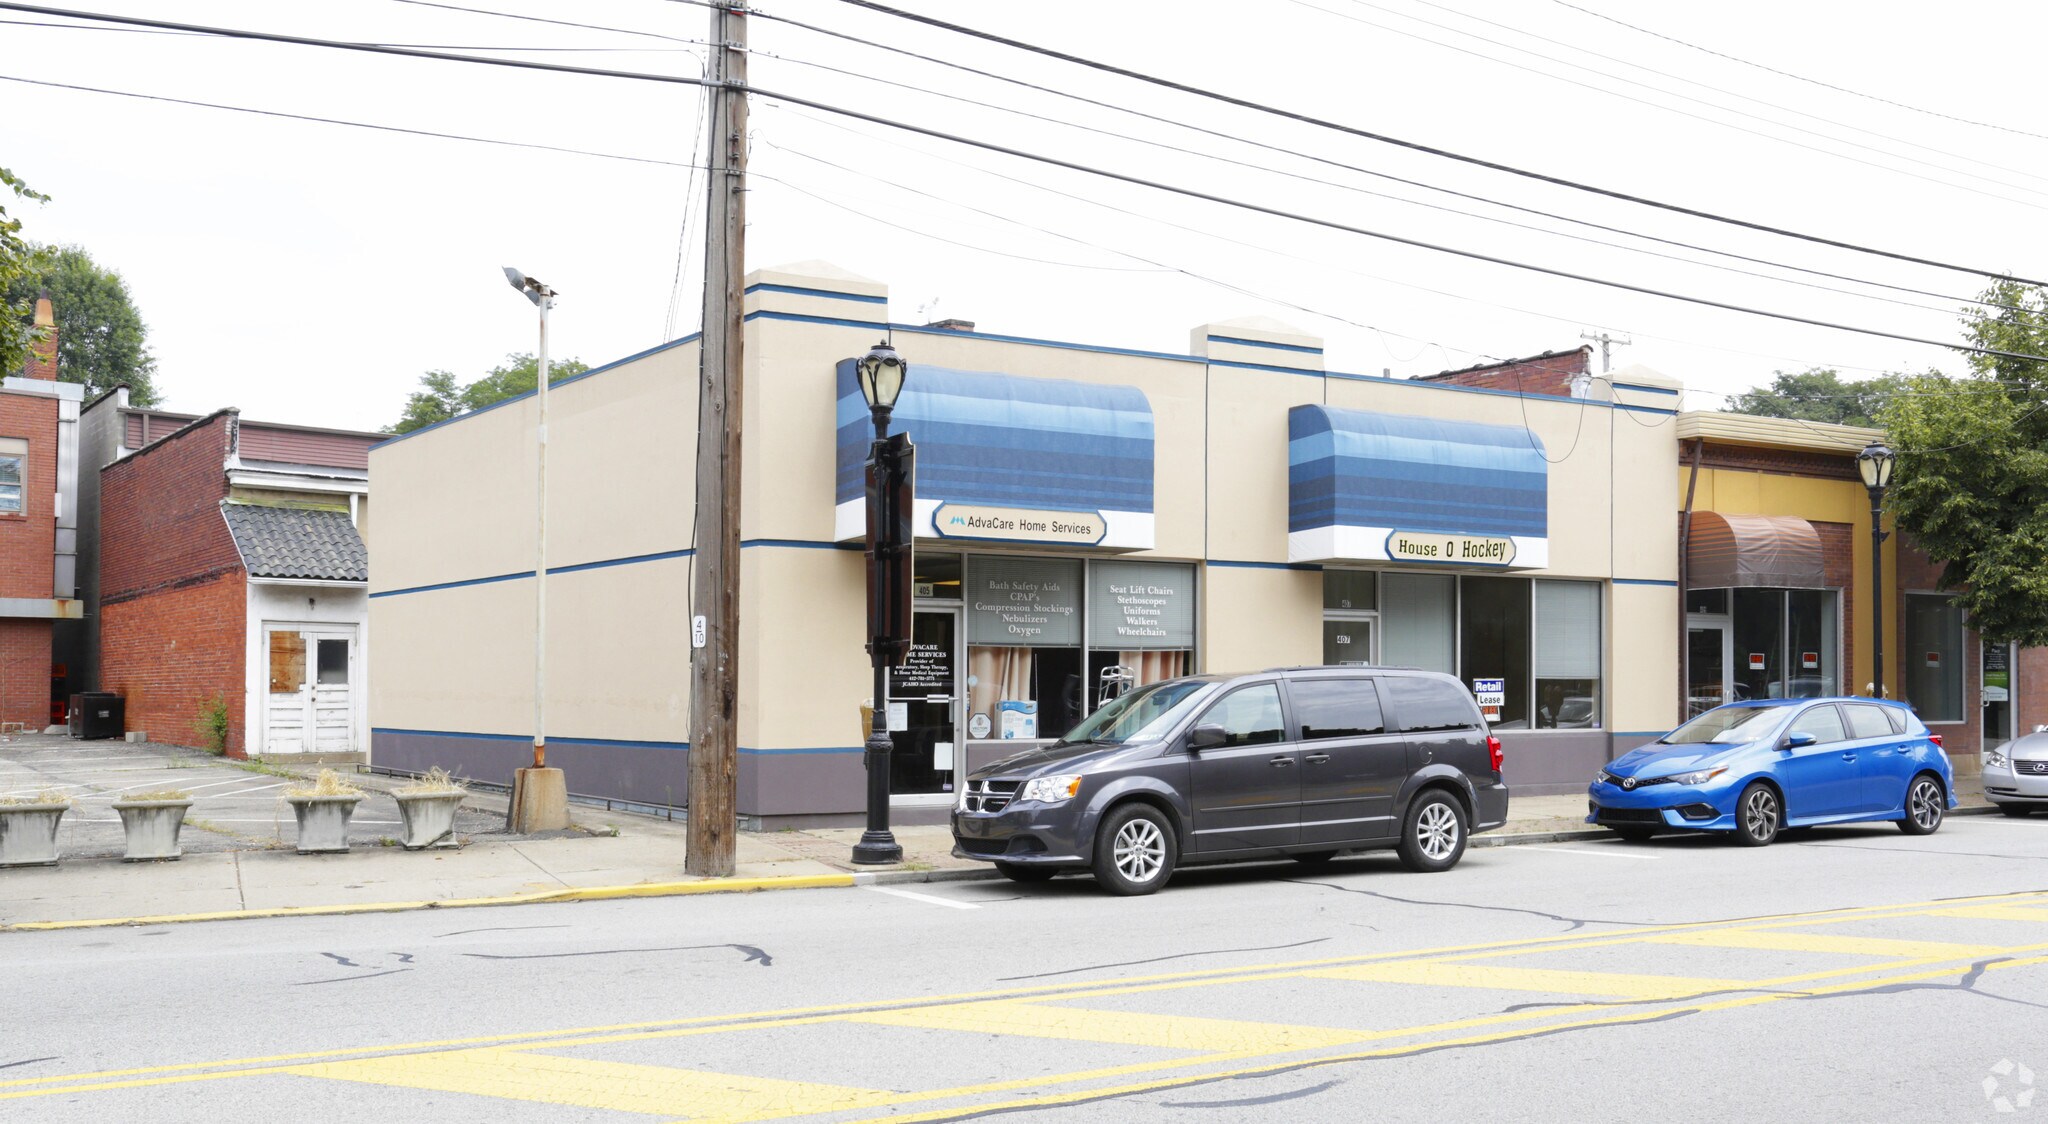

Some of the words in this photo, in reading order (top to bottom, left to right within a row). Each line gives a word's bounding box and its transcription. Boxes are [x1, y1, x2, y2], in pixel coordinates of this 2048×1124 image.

[967, 516, 1014, 530] AdvaCare
[1019, 519, 1047, 532] Home
[1051, 521, 1091, 535] Services
[1399, 539, 1438, 557] House
[1446, 541, 1454, 558] O
[1462, 539, 1507, 561] Hockey
[919, 586, 930, 595] 405
[989, 580, 1009, 590] Bath
[1012, 582, 1039, 592] Safety
[1042, 583, 1060, 592] Aids
[1109, 584, 1127, 594] Seat
[1130, 585, 1145, 595] Lift
[1147, 585, 1174, 595] Chairs
[1010, 591, 1040, 602] CPAP's
[1117, 595, 1167, 607] Stethoscopes
[975, 601, 1030, 614] Compression
[1033, 603, 1074, 616] Stockings
[1123, 606, 1161, 616] Uniforms
[1002, 613, 1048, 624] Nebulizers
[1126, 616, 1158, 626] Walkers
[696, 620, 702, 630] 4
[1008, 624, 1041, 637] Oxygen
[1117, 626, 1167, 636] Wheelchairs
[695, 633, 704, 644] 10
[1337, 635, 1350, 644] 407
[1475, 681, 1502, 692] Retail
[1480, 695, 1501, 704] Lease
